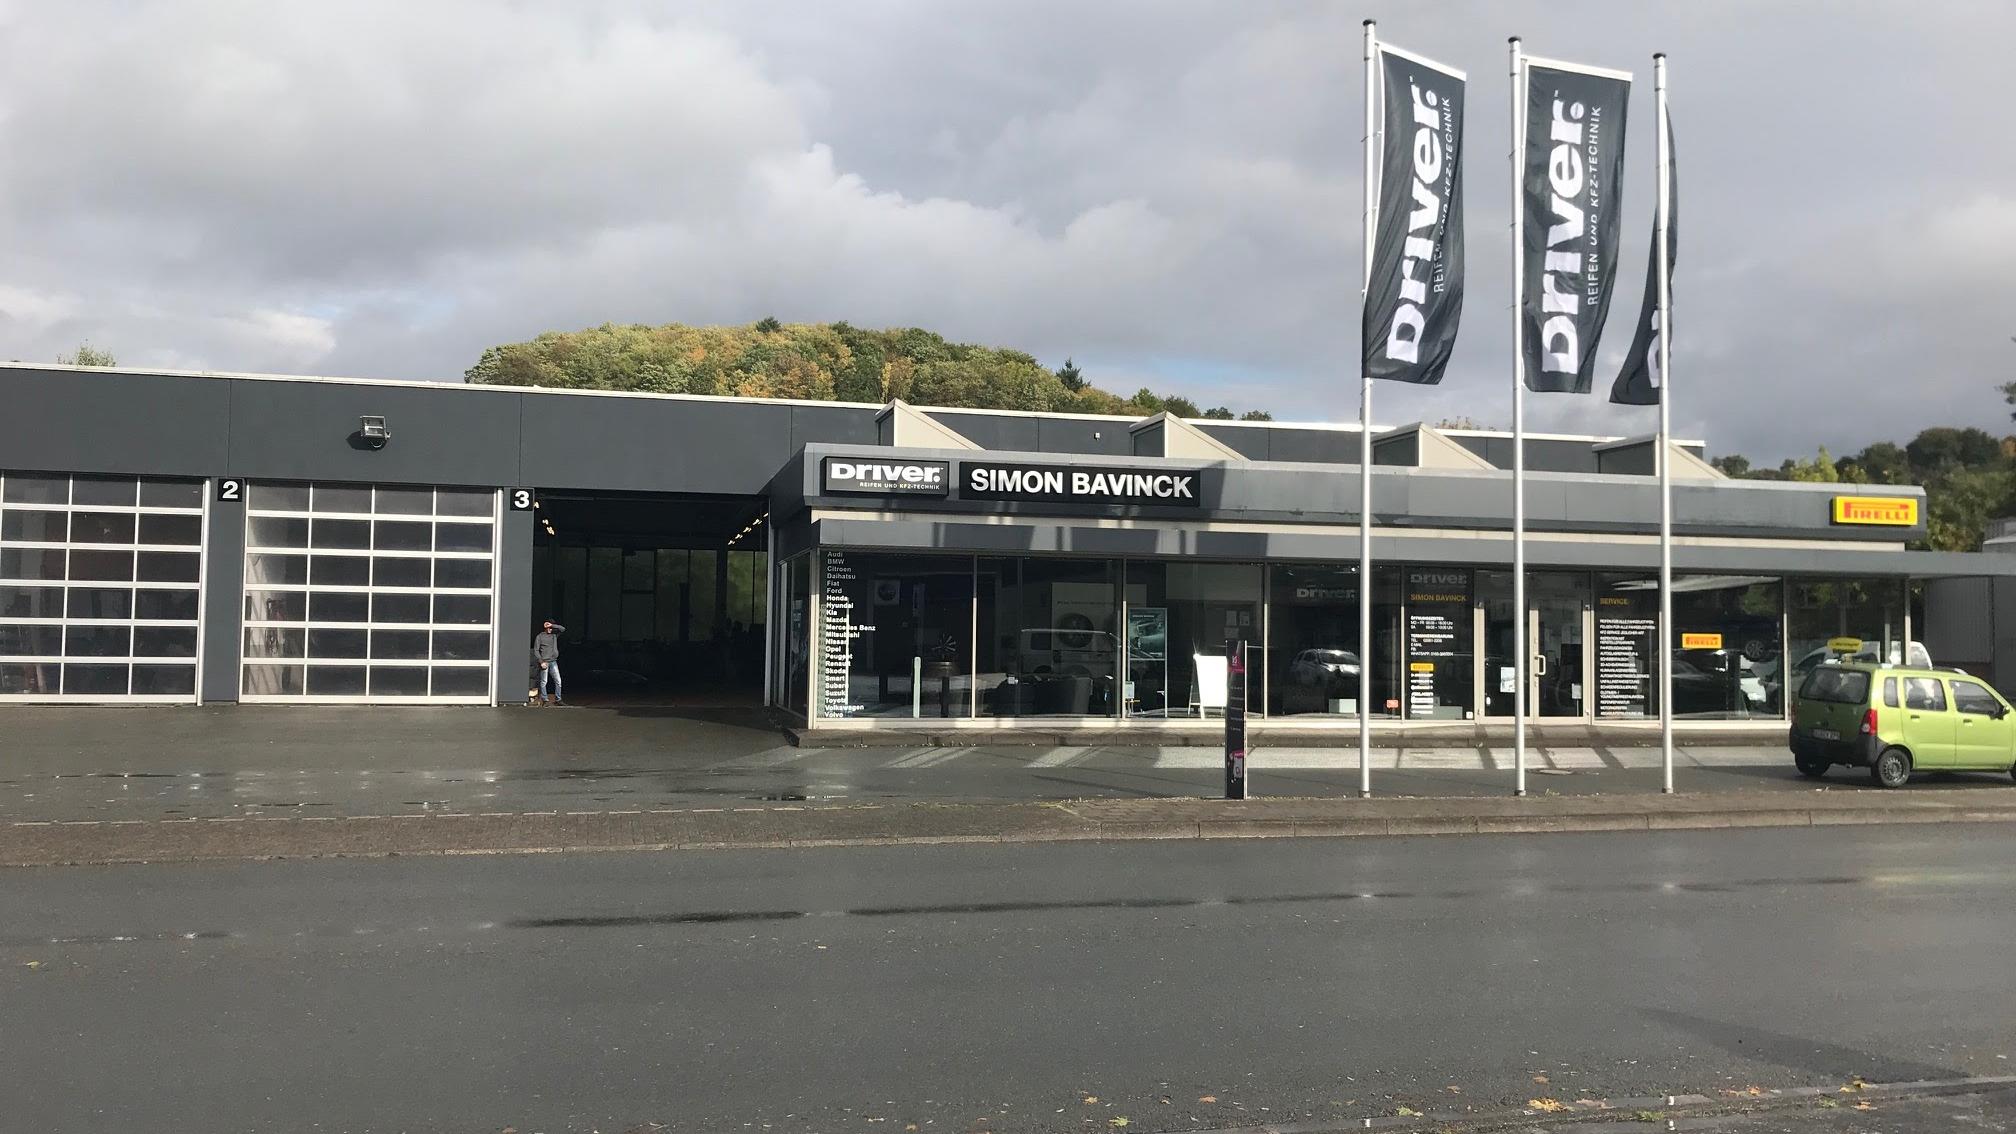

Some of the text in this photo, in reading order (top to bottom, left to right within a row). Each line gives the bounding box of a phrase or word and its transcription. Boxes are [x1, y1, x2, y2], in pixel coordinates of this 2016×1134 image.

[1441, 97, 1453, 197] KFZ-TECHNIK
[1587, 106, 1601, 306] REIFEN UND KFZ-TECHNIK
[223, 480, 239, 499] 2
[859, 481, 941, 491] REIFEN UND KFZ-TECHNIK
[971, 468, 1193, 499] SIMON BAVINCK
[514, 490, 530, 509] 3
[1843, 502, 1909, 520] PIRELLI
[826, 602, 854, 610] Hyundai
[1410, 593, 1435, 601] SIMON
[825, 653, 853, 661] Peuget
[826, 645, 842, 653] Opel
